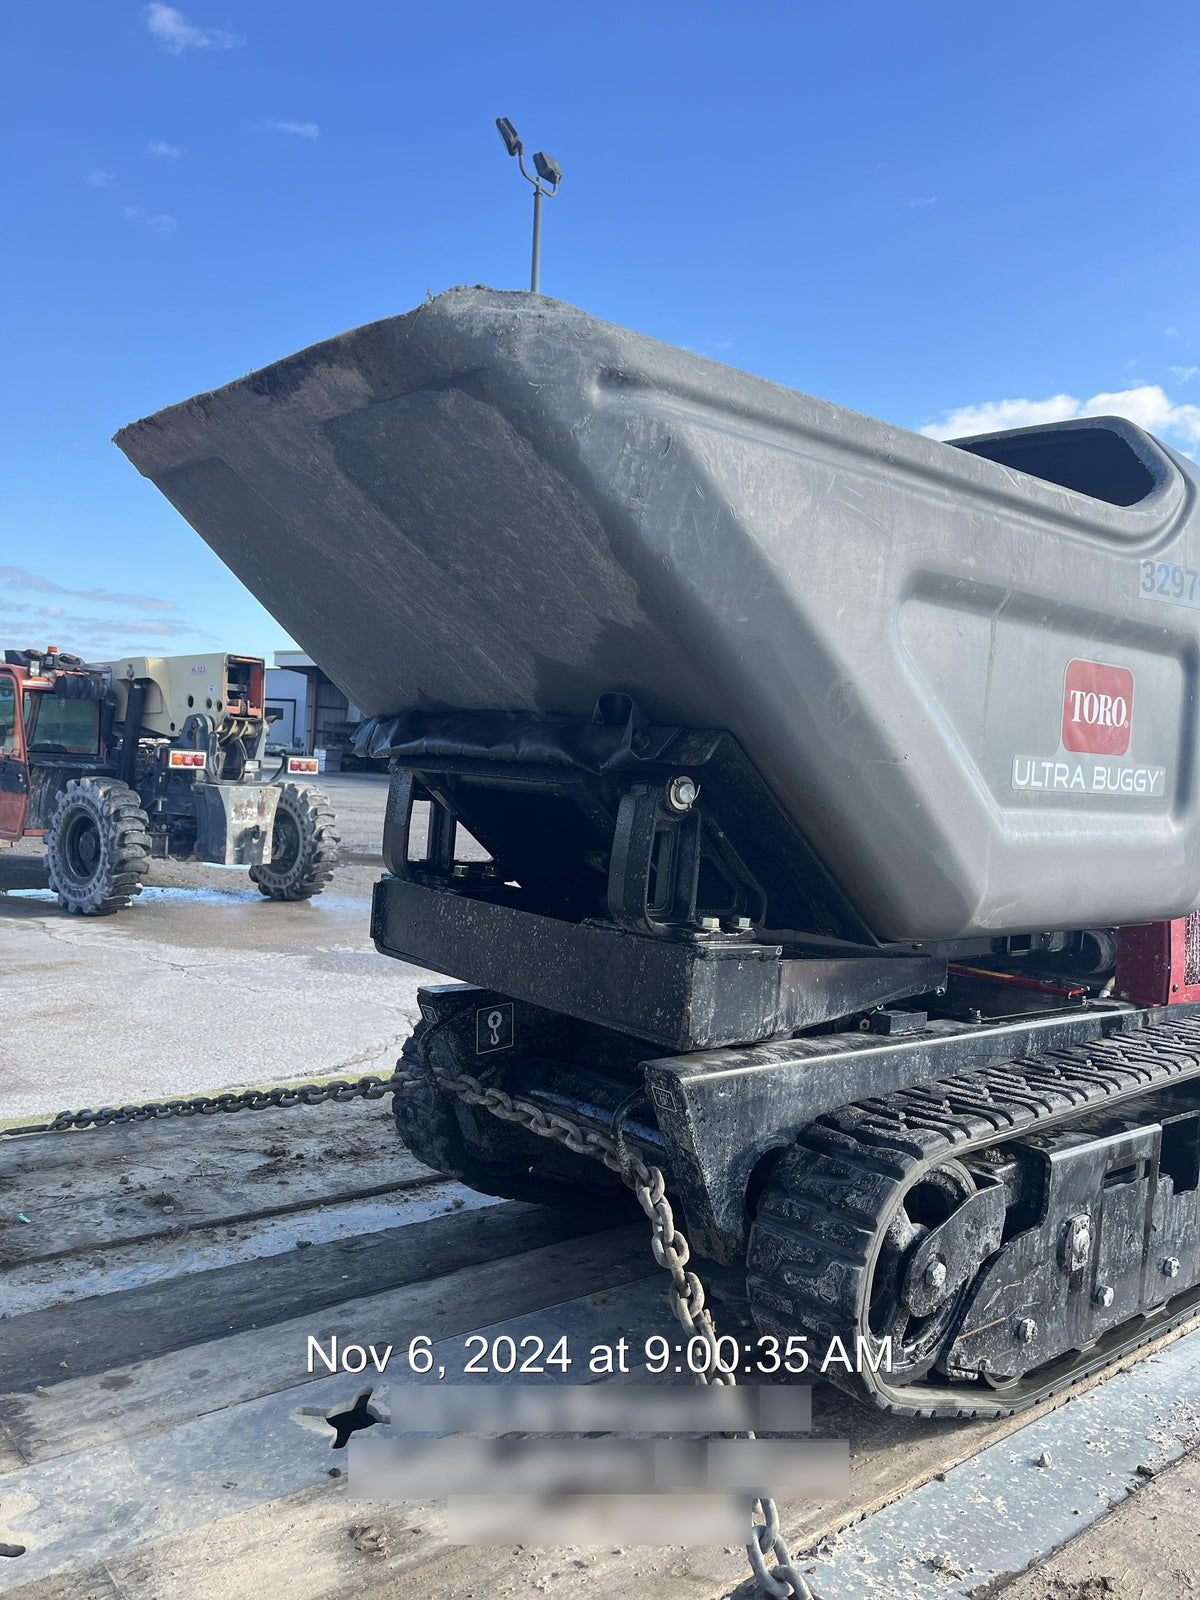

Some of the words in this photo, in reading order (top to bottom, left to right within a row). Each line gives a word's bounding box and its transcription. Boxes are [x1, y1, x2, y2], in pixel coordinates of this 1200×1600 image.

[1070, 690, 1127, 728] TORO
[1014, 760, 1085, 789] ULTRA
[1093, 766, 1159, 792] BUGGY
